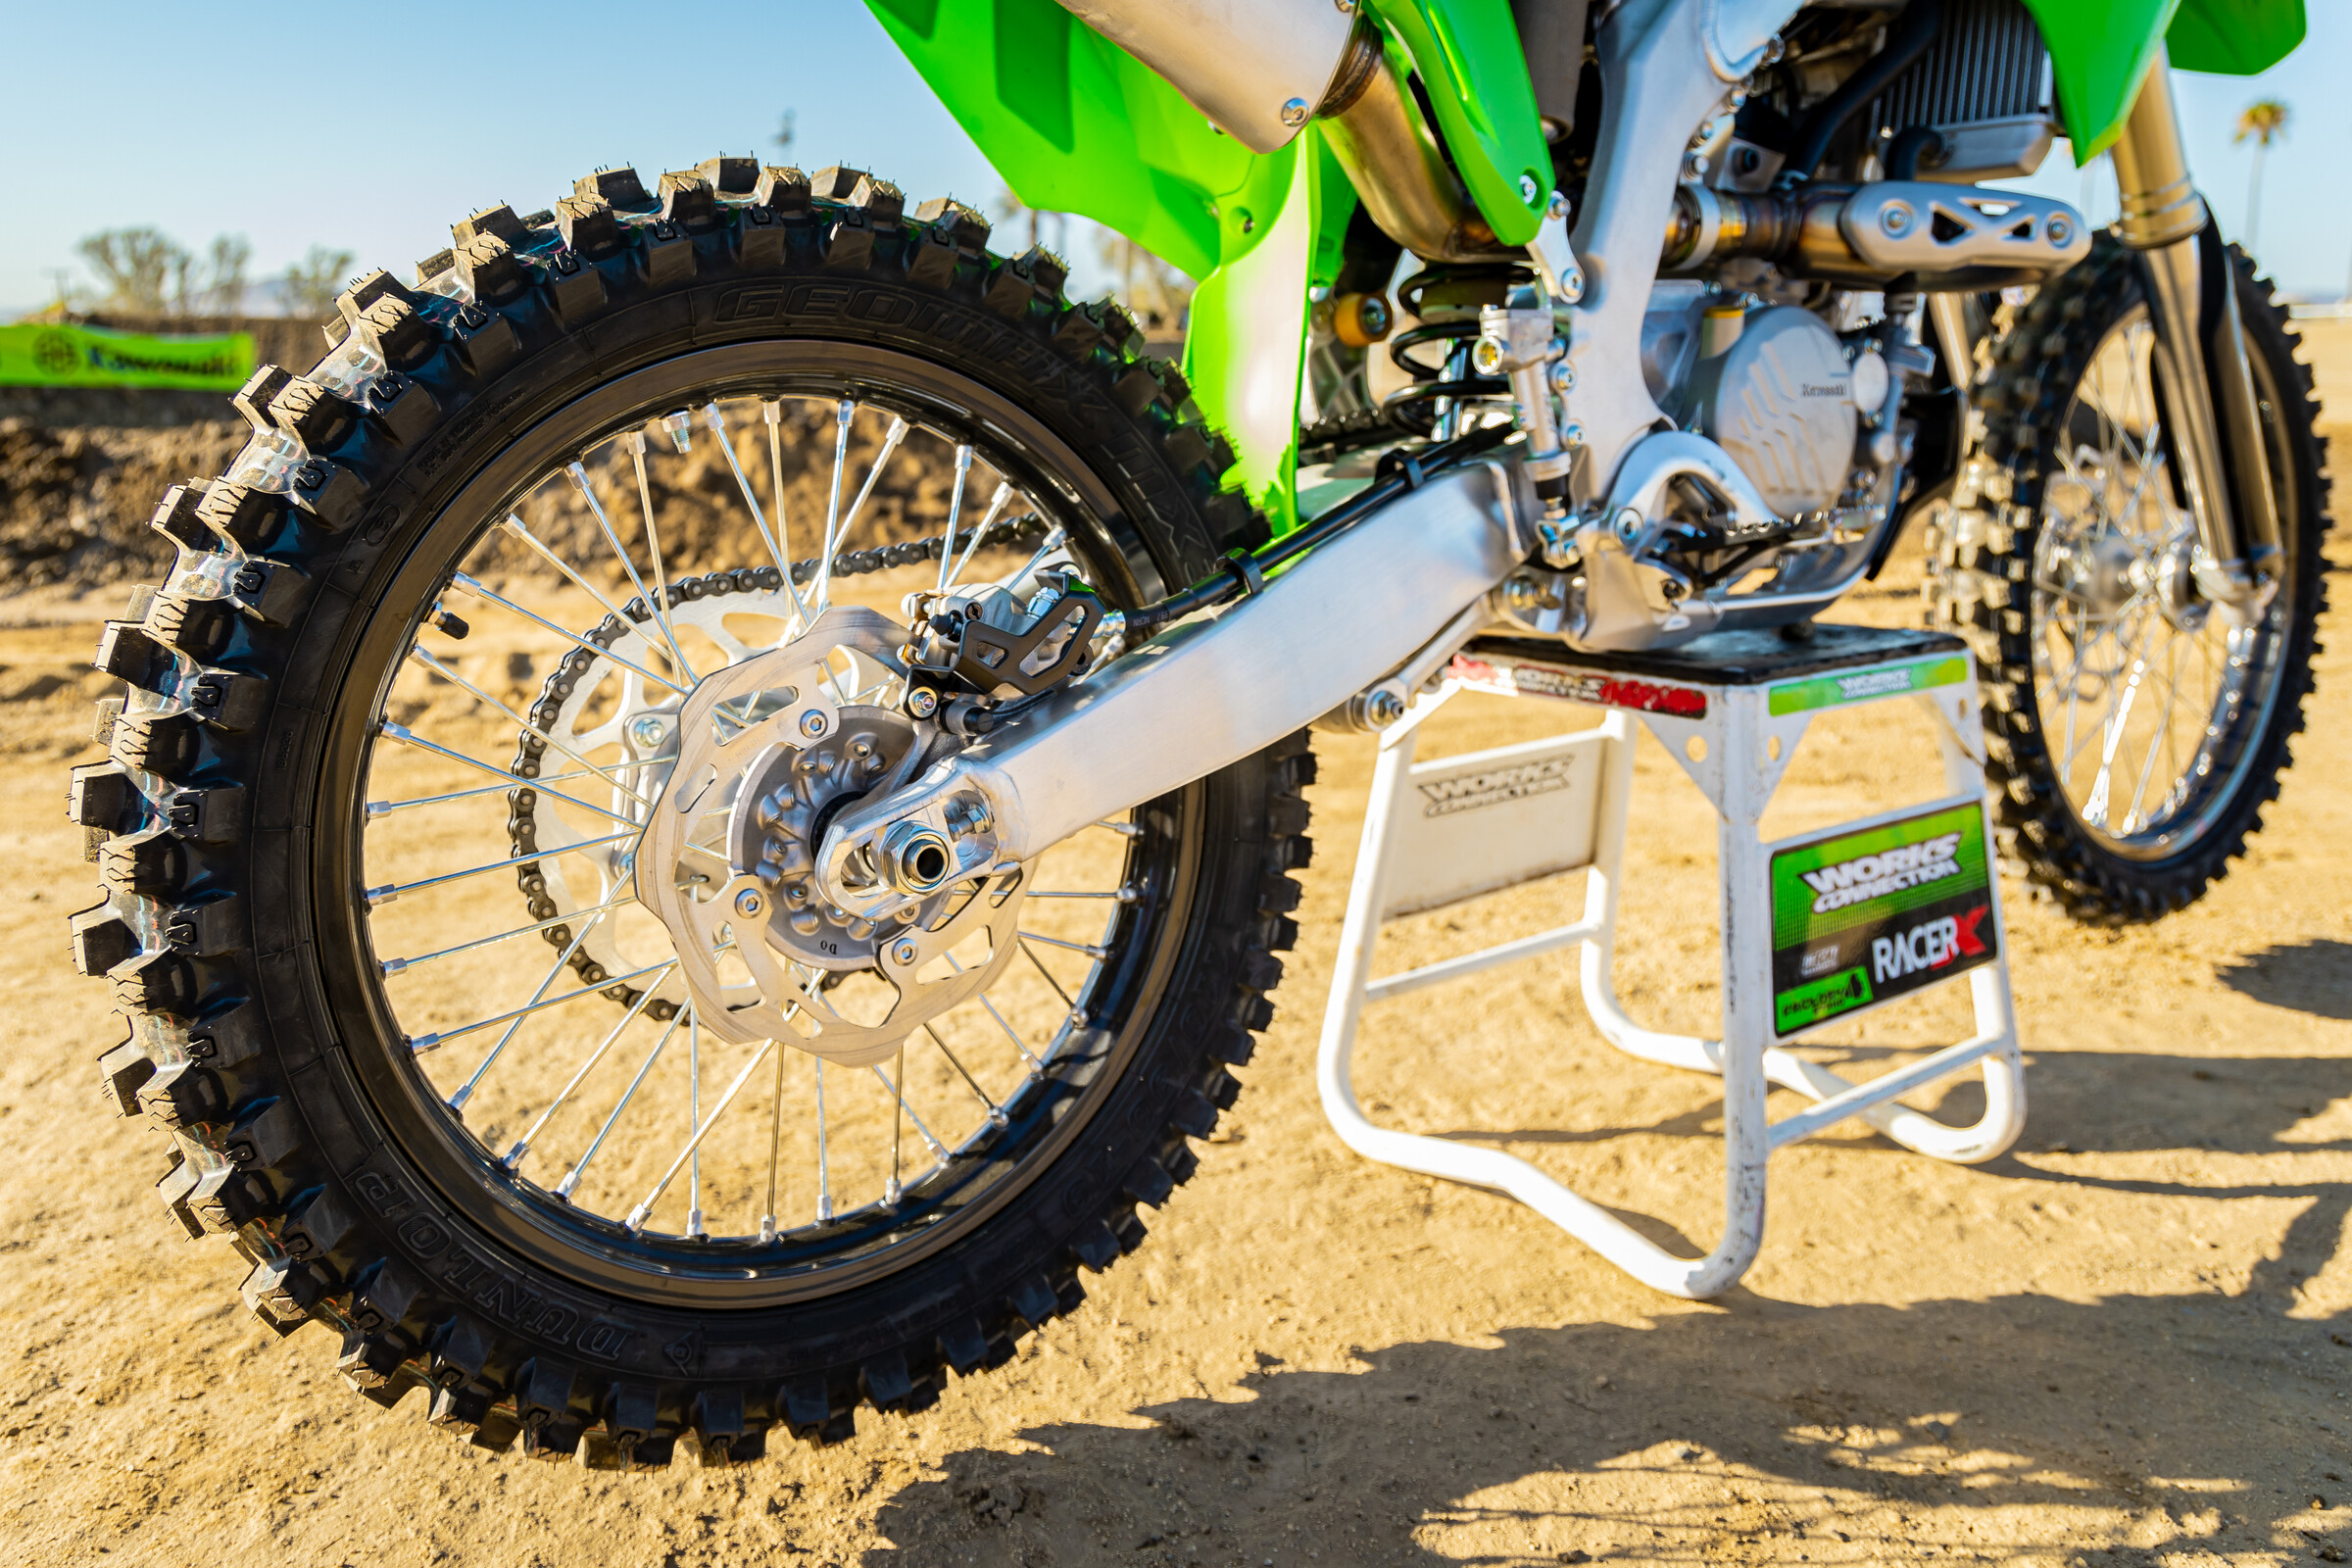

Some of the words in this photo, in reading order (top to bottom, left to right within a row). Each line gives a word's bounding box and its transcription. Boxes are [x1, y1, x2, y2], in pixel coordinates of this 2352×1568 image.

[714, 282, 1108, 428] GEOMAX
[1418, 754, 1575, 803] WORKS
[1800, 832, 1962, 894] WORKS
[1813, 857, 1962, 914] CONNECTION
[355, 1171, 634, 1361] DUNLOP
